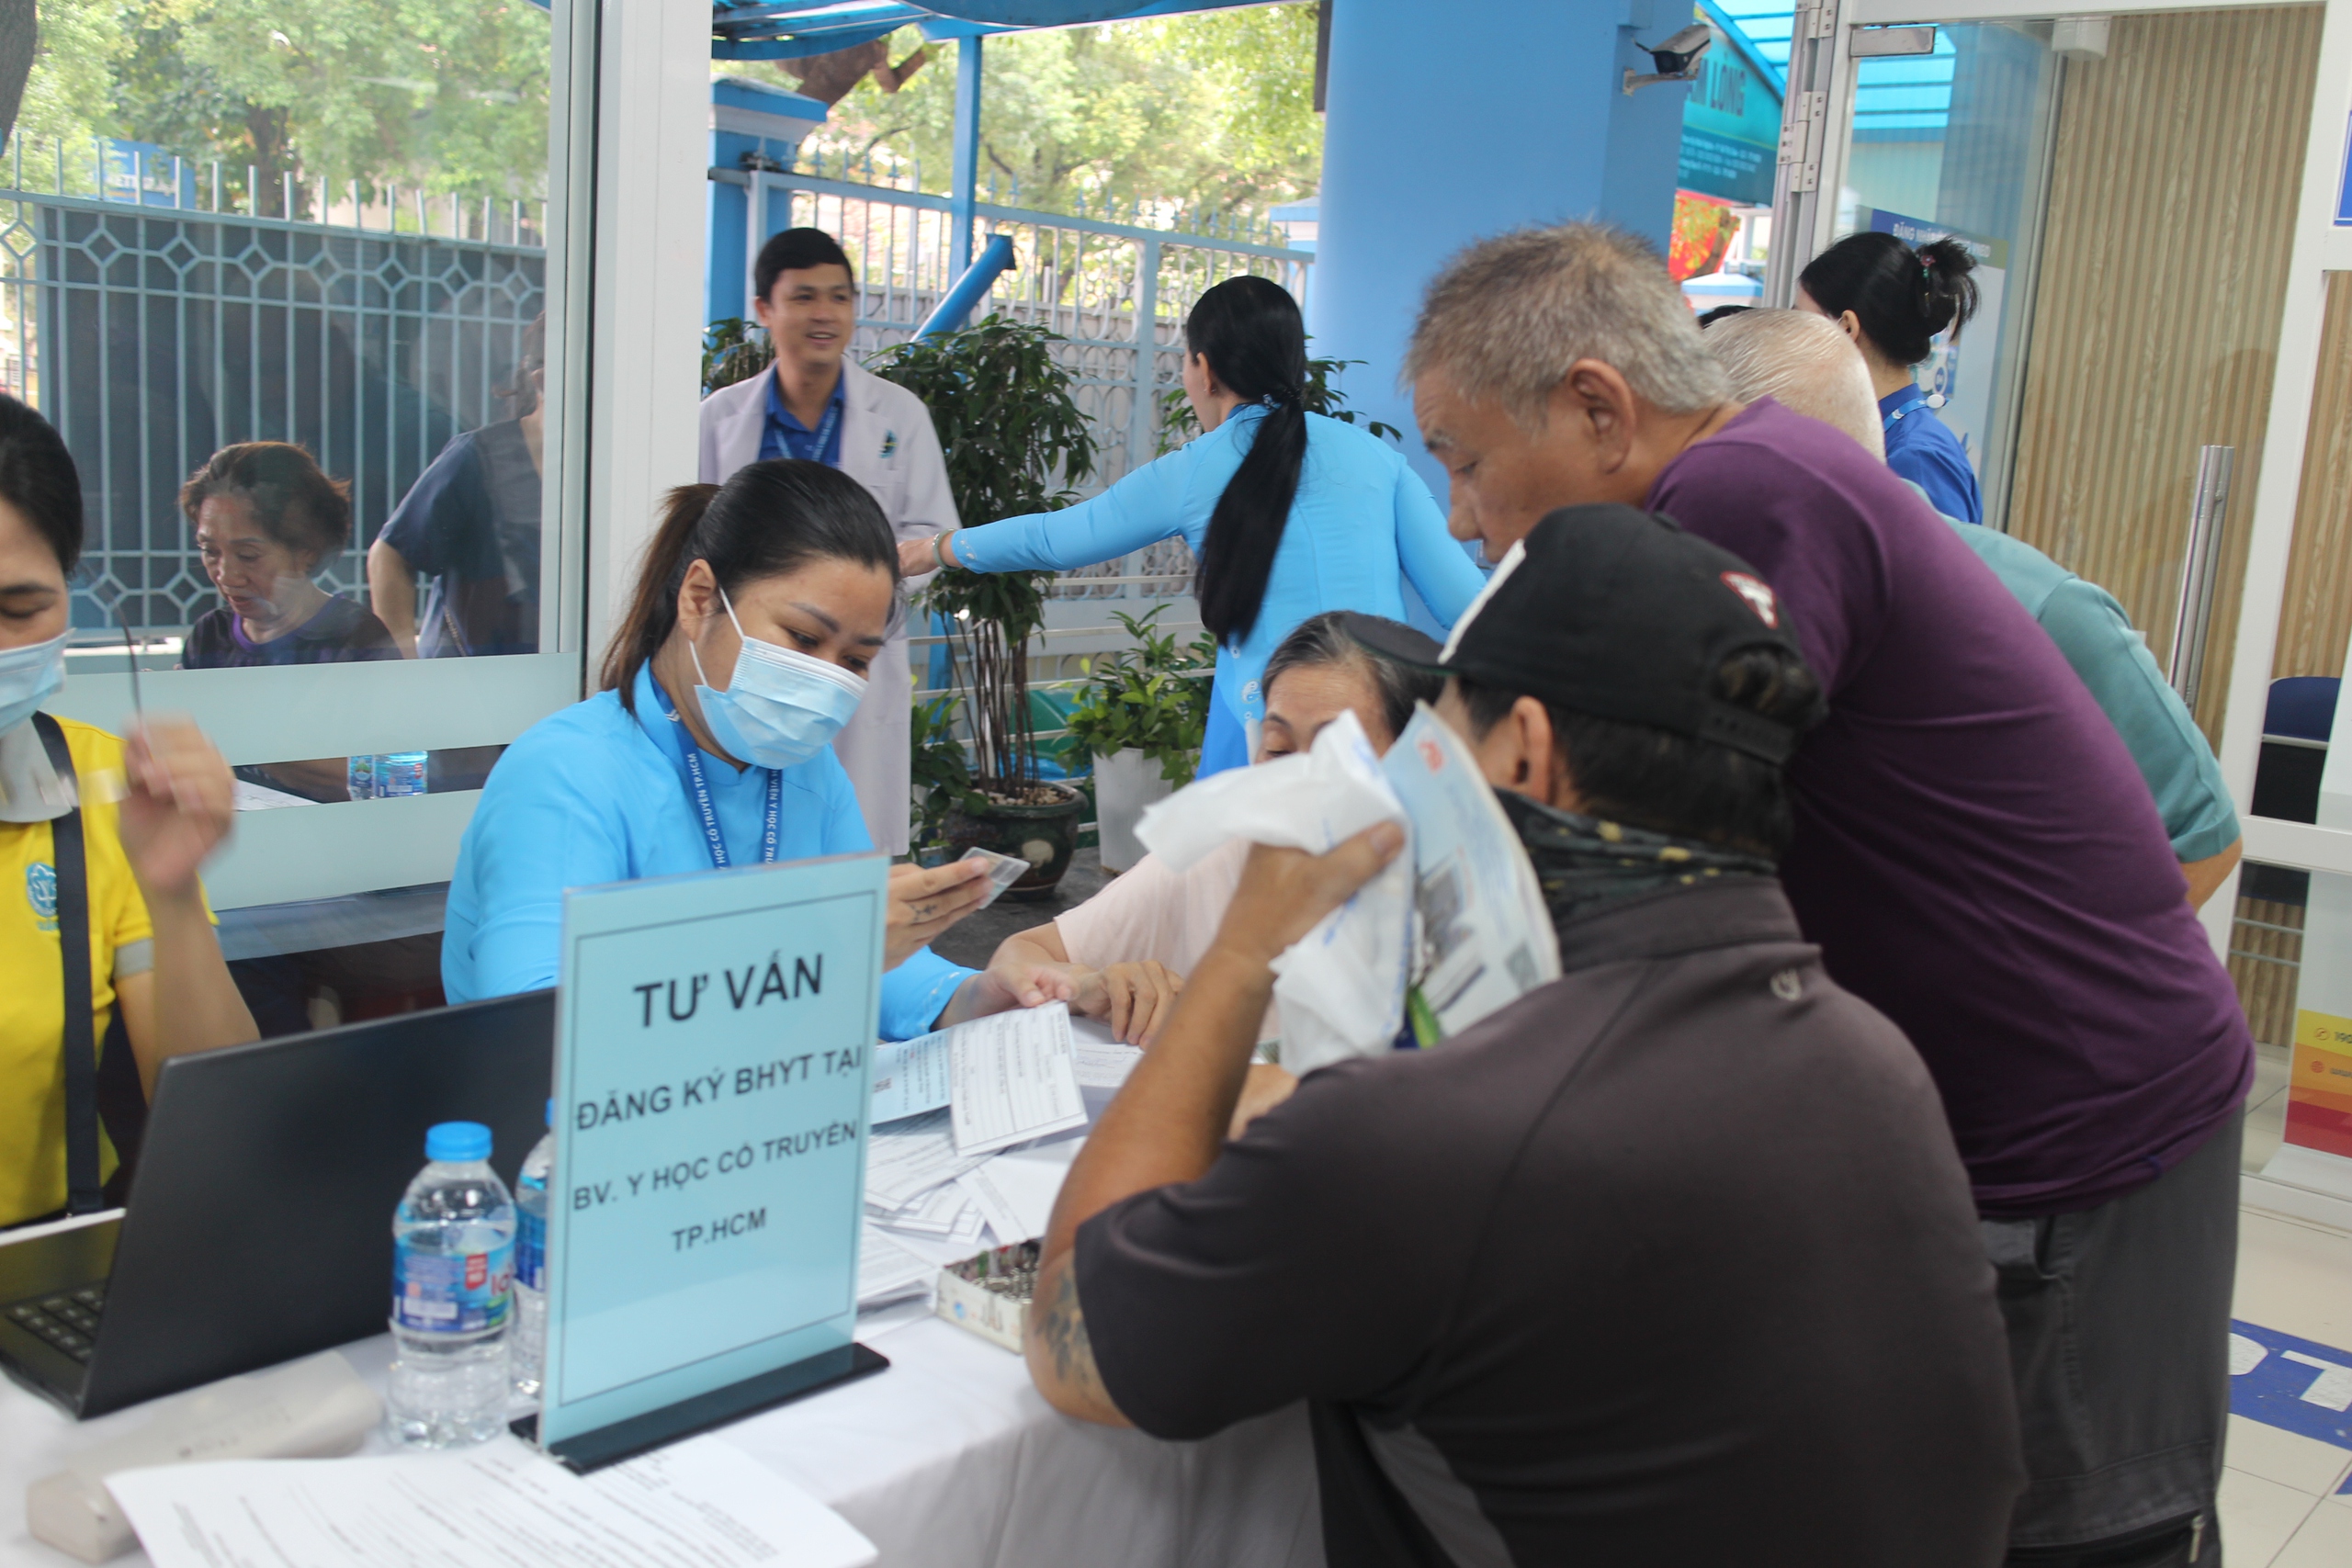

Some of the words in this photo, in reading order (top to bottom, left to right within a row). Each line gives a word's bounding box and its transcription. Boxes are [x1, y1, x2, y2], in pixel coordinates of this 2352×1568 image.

[633, 972, 710, 1029] TƯ
[723, 948, 824, 1010] VẤN
[574, 1084, 673, 1132] ĐĂNG
[682, 1066, 726, 1108] KÝ
[734, 1053, 815, 1097] BHYT
[822, 1044, 864, 1077] TẠI
[572, 1180, 618, 1212] BV.
[627, 1171, 646, 1196] Y
[651, 1156, 711, 1192] HỌC
[672, 1206, 768, 1254] TP.HCM
